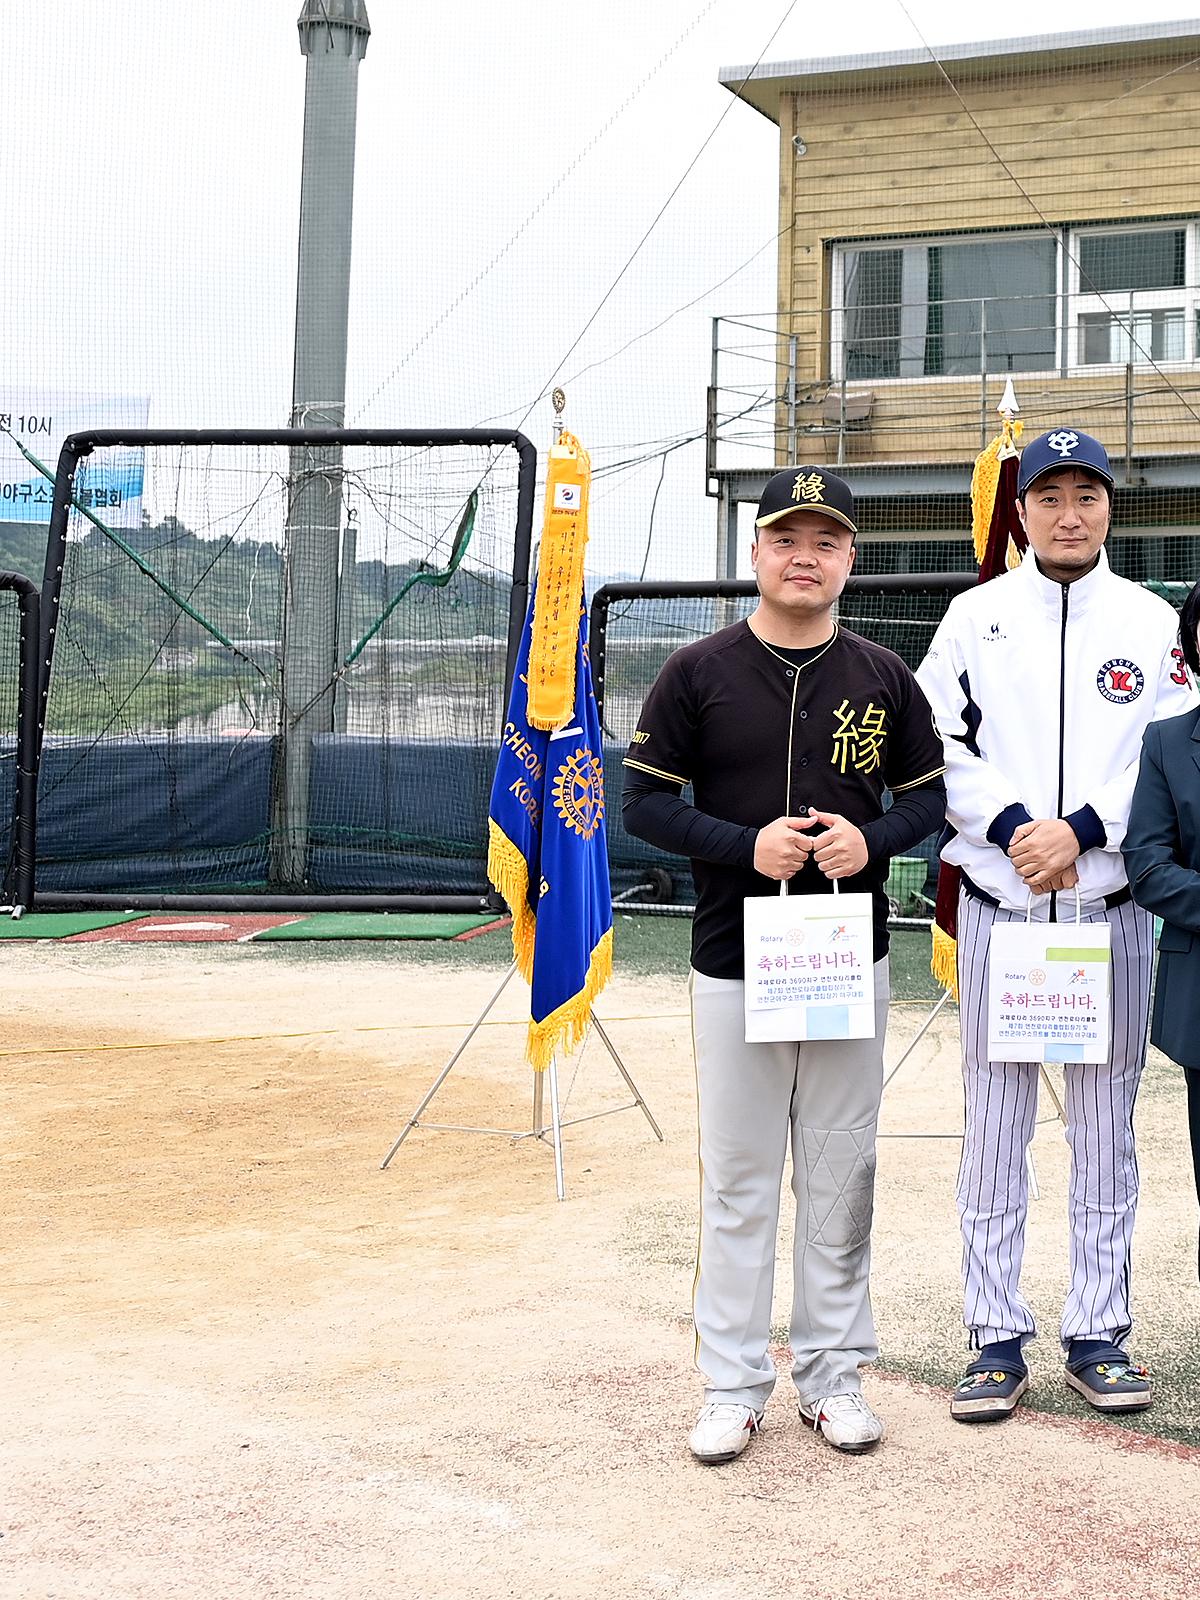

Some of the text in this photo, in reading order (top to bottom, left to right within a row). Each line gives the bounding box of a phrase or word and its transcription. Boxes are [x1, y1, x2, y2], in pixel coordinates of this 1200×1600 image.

[18, 415, 52, 436] 10시
[757, 951, 860, 972] 축하드립니다.
[1000, 992, 1096, 1010] 축하드립니다.
